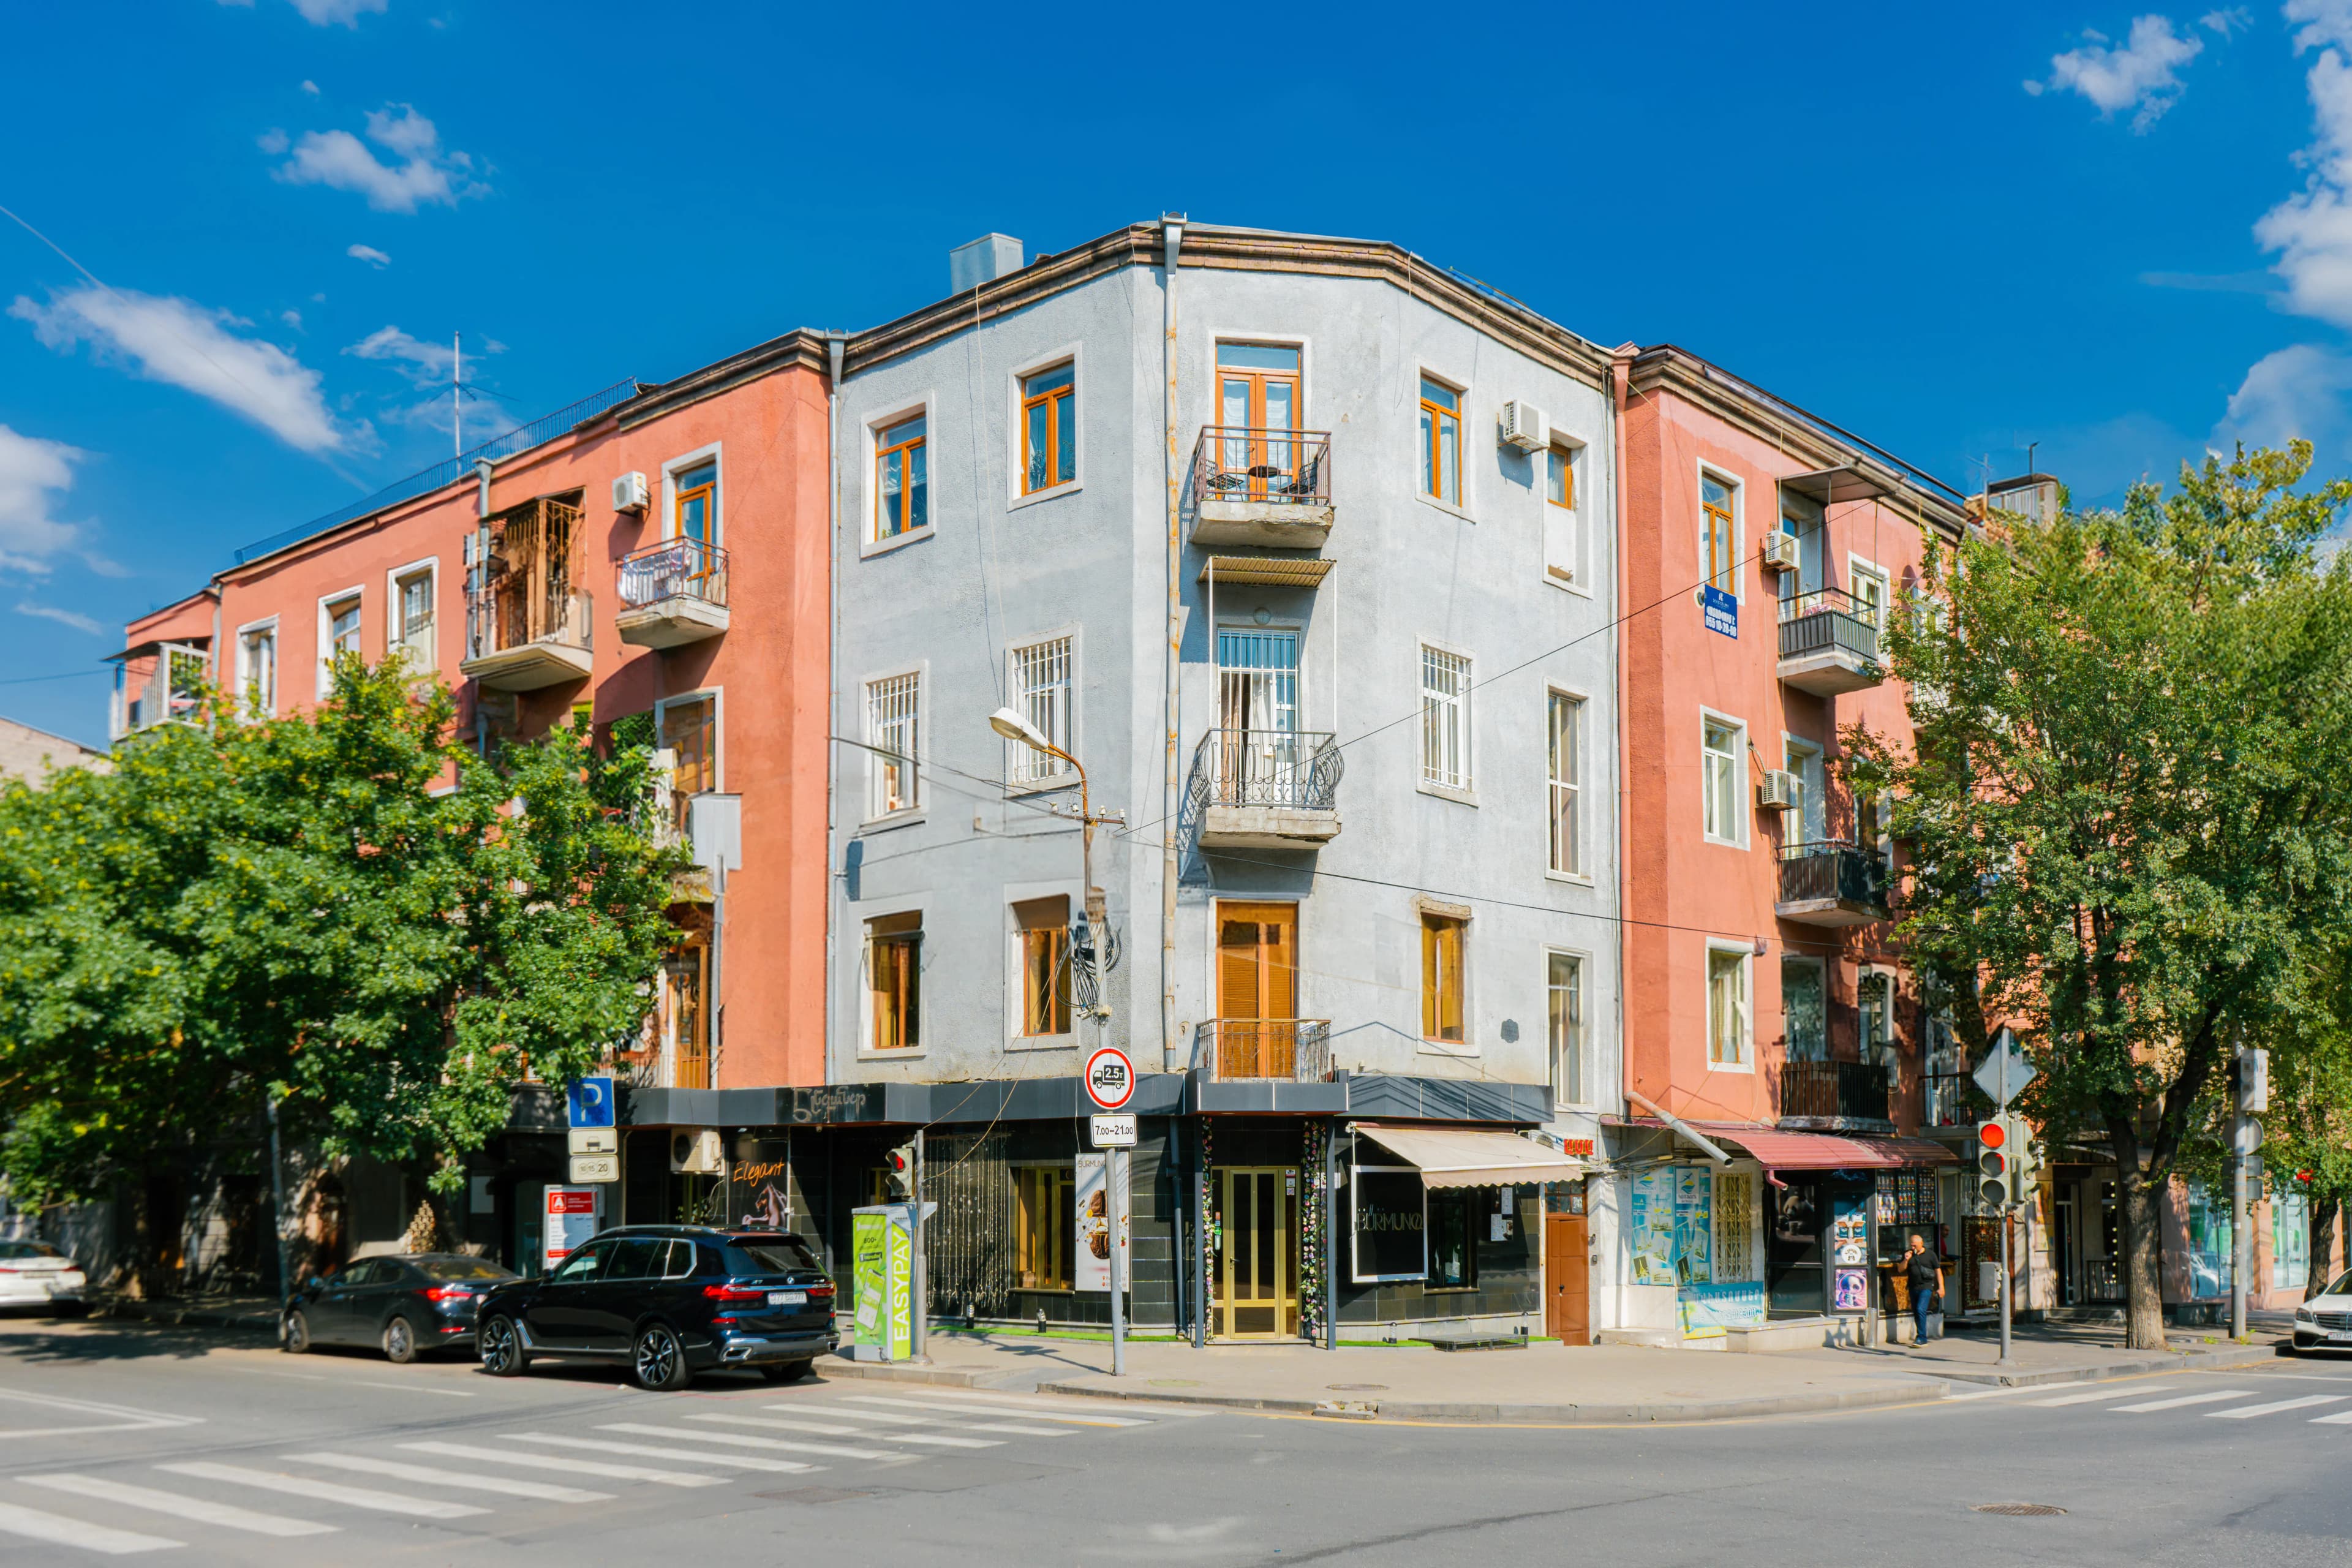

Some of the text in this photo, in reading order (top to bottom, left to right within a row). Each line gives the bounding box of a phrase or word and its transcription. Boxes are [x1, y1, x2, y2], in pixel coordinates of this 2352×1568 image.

[580, 1083, 603, 1122] P
[598, 1163, 608, 1172] 20
[733, 1156, 785, 1187] Elegant
[892, 1232, 910, 1342] EASYPAY
